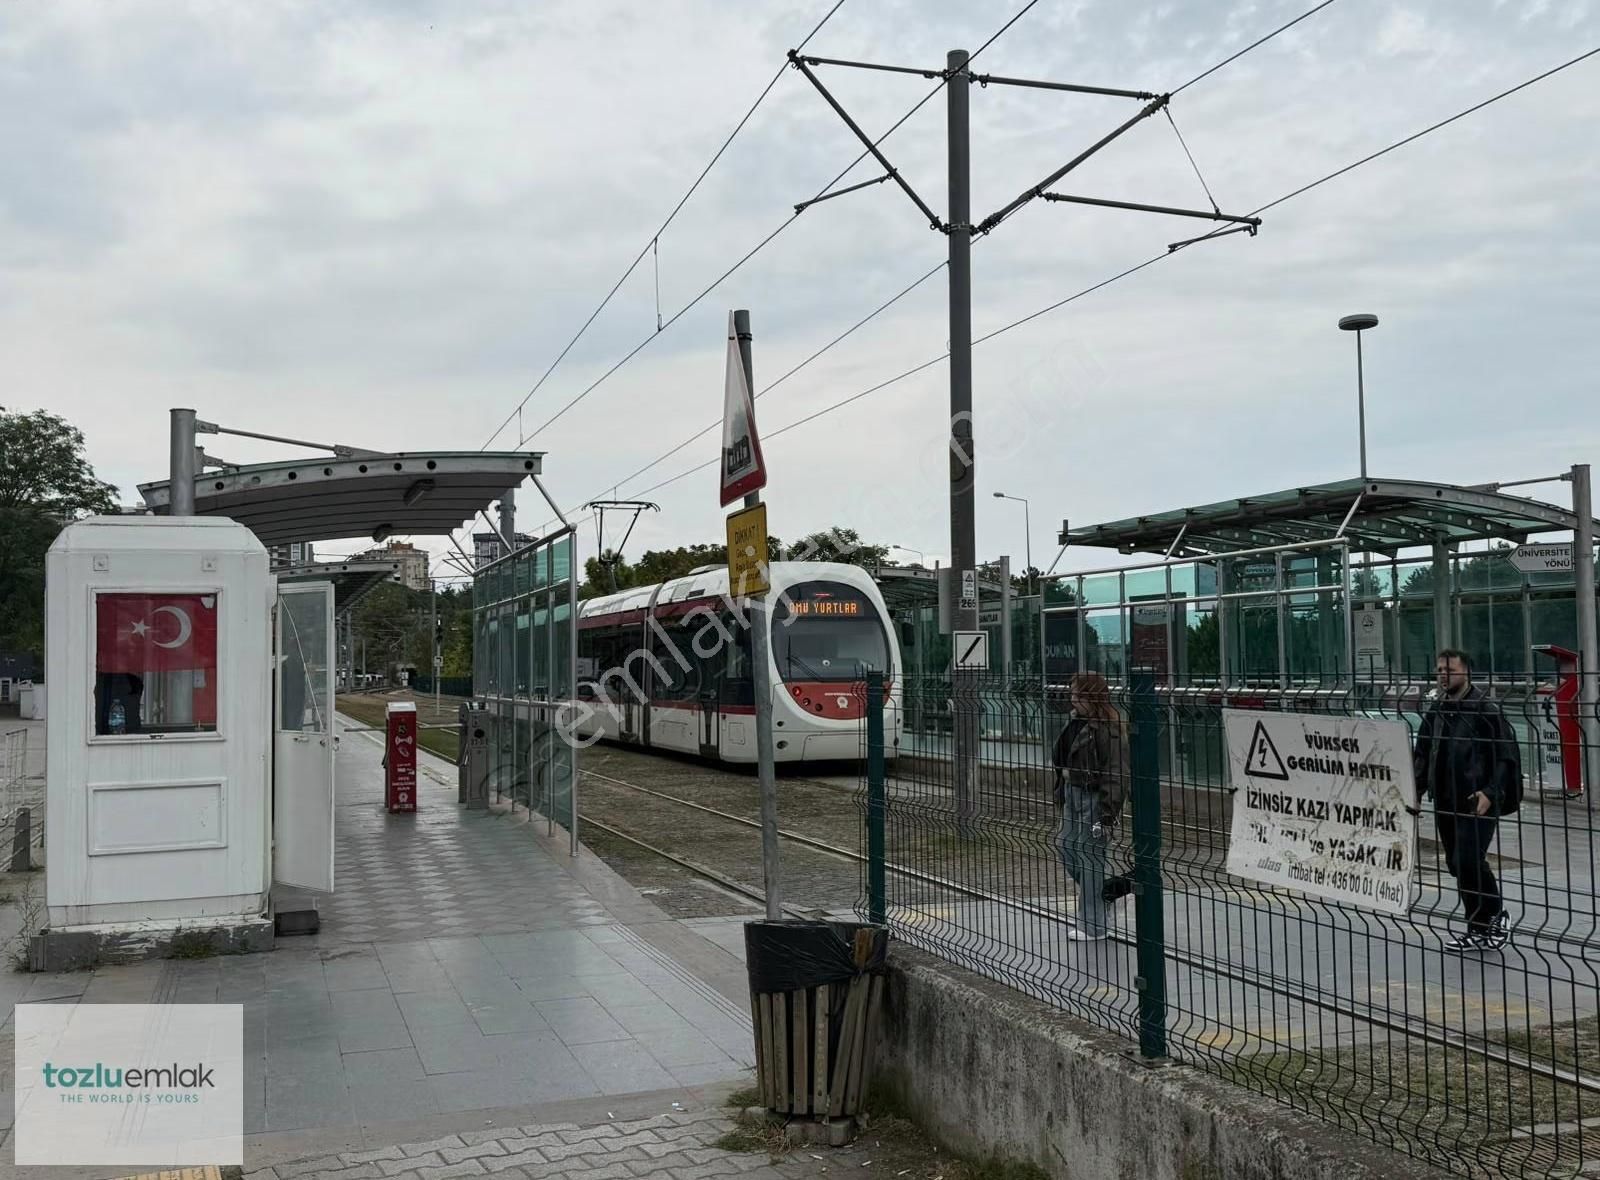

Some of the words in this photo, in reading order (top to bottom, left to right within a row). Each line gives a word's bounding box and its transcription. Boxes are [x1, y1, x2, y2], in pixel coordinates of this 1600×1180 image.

[1517, 547, 1570, 557] ÜNİVERSİTE
[814, 602, 857, 614] YURTLAR
[1246, 786, 1293, 815] İZİNSİZ
[1297, 798, 1330, 821] KAZI
[1334, 803, 1397, 832] YAPMAK
[1332, 871, 1348, 890] 436
